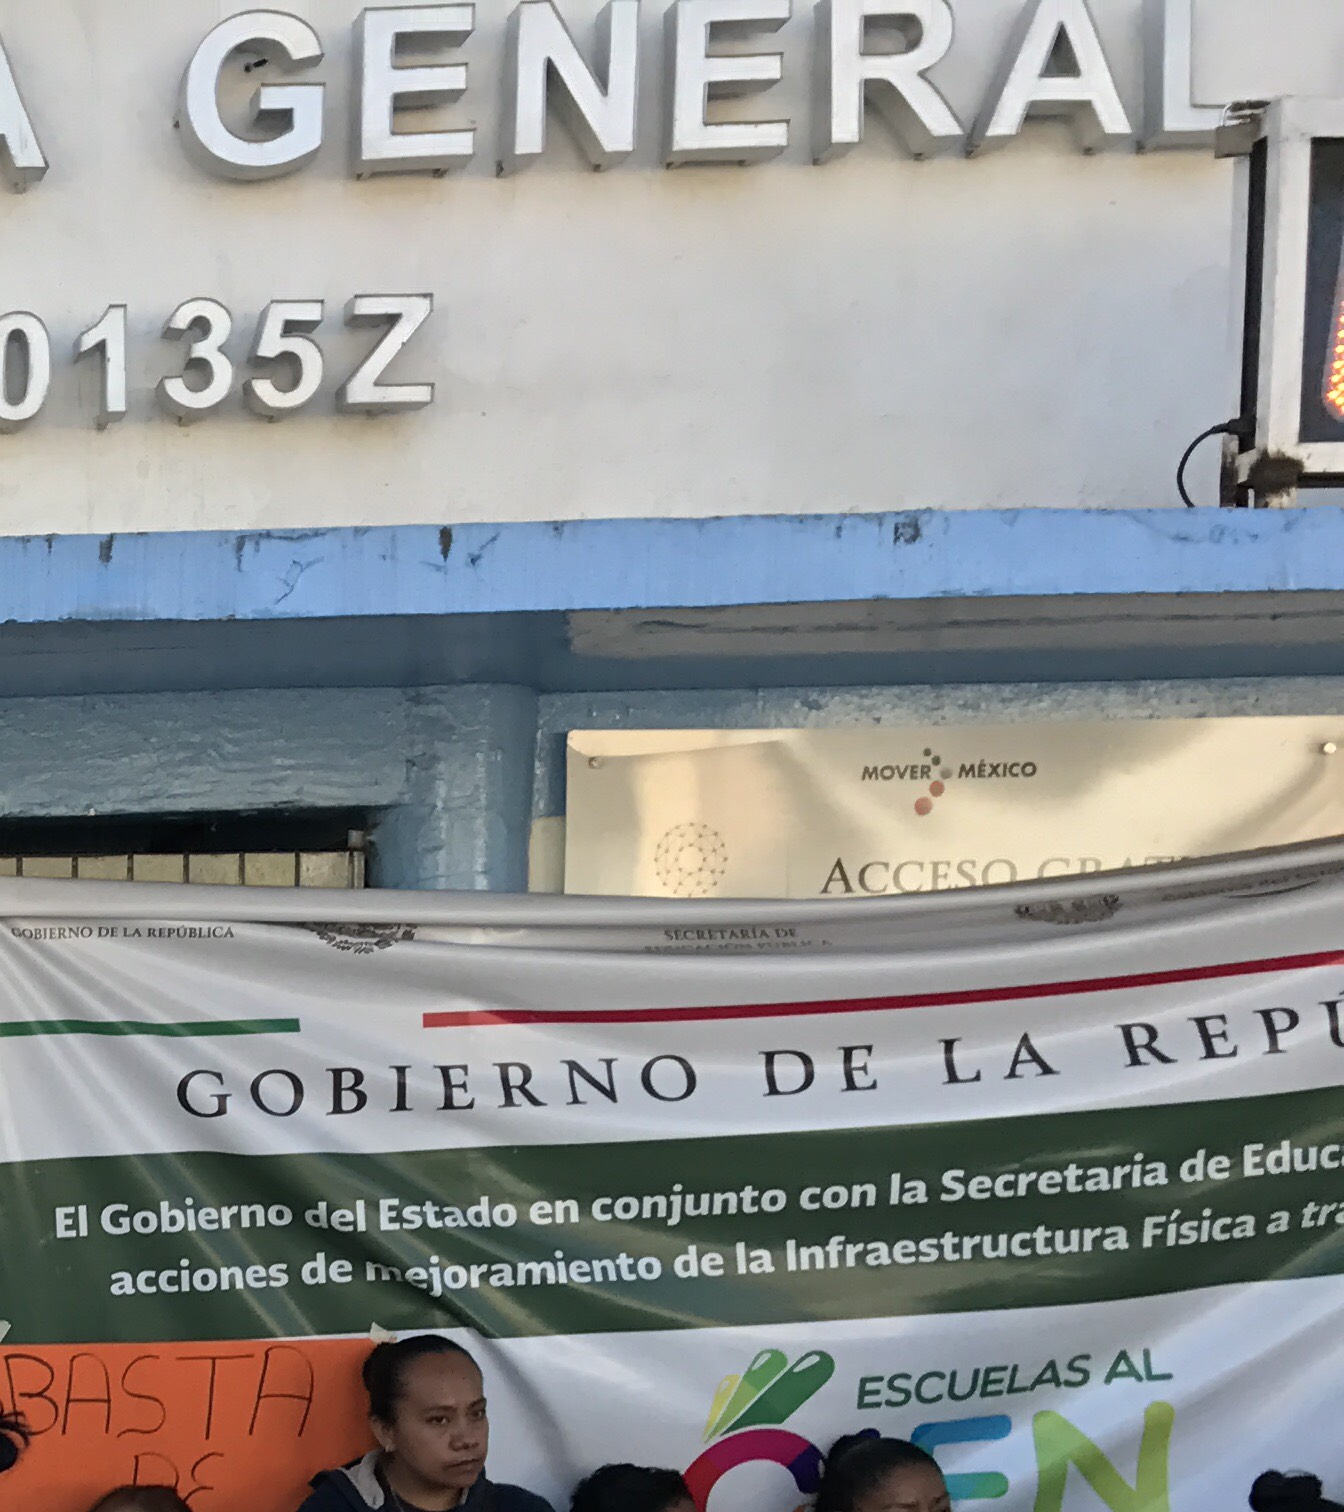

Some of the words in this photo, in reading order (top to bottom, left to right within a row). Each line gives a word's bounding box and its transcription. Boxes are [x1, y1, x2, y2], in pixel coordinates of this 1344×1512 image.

[180, 0, 1230, 182] GENERAL
[862, 764, 931, 782] MOVER
[958, 758, 1037, 780] MÉXICO
[12, 926, 93, 940] GOBIERNO
[98, 926, 119, 938] DE
[123, 927, 143, 938] LA
[147, 924, 235, 939] REPÚBLICA
[664, 925, 770, 941] SECRETARÍA
[177, 1053, 698, 1118] GOBIERNO
[759, 1043, 879, 1097] DE
[938, 1031, 1061, 1085] LA
[55, 1204, 89, 1239] El
[101, 1196, 292, 1237] Gobierno
[305, 1200, 367, 1233] del
[379, 1193, 517, 1235] Estado
[529, 1198, 580, 1228] en
[591, 1183, 787, 1230] conjunto
[799, 1183, 876, 1213] con
[889, 1172, 929, 1207] la
[940, 1153, 1169, 1202] Secretaria
[1179, 1147, 1231, 1184] de
[110, 1258, 289, 1298] acciones
[301, 1251, 353, 1287] de
[366, 1245, 663, 1299] mejoramiento
[674, 1244, 725, 1280] de
[735, 1240, 775, 1276] la
[786, 1223, 1129, 1272] Infraestructura
[1141, 1208, 1256, 1249] Física
[1265, 1212, 1291, 1236] a
[3, 1346, 315, 1439] BASTA
[857, 1353, 1091, 1410] ESCUELAS
[1104, 1347, 1175, 1385] AL
